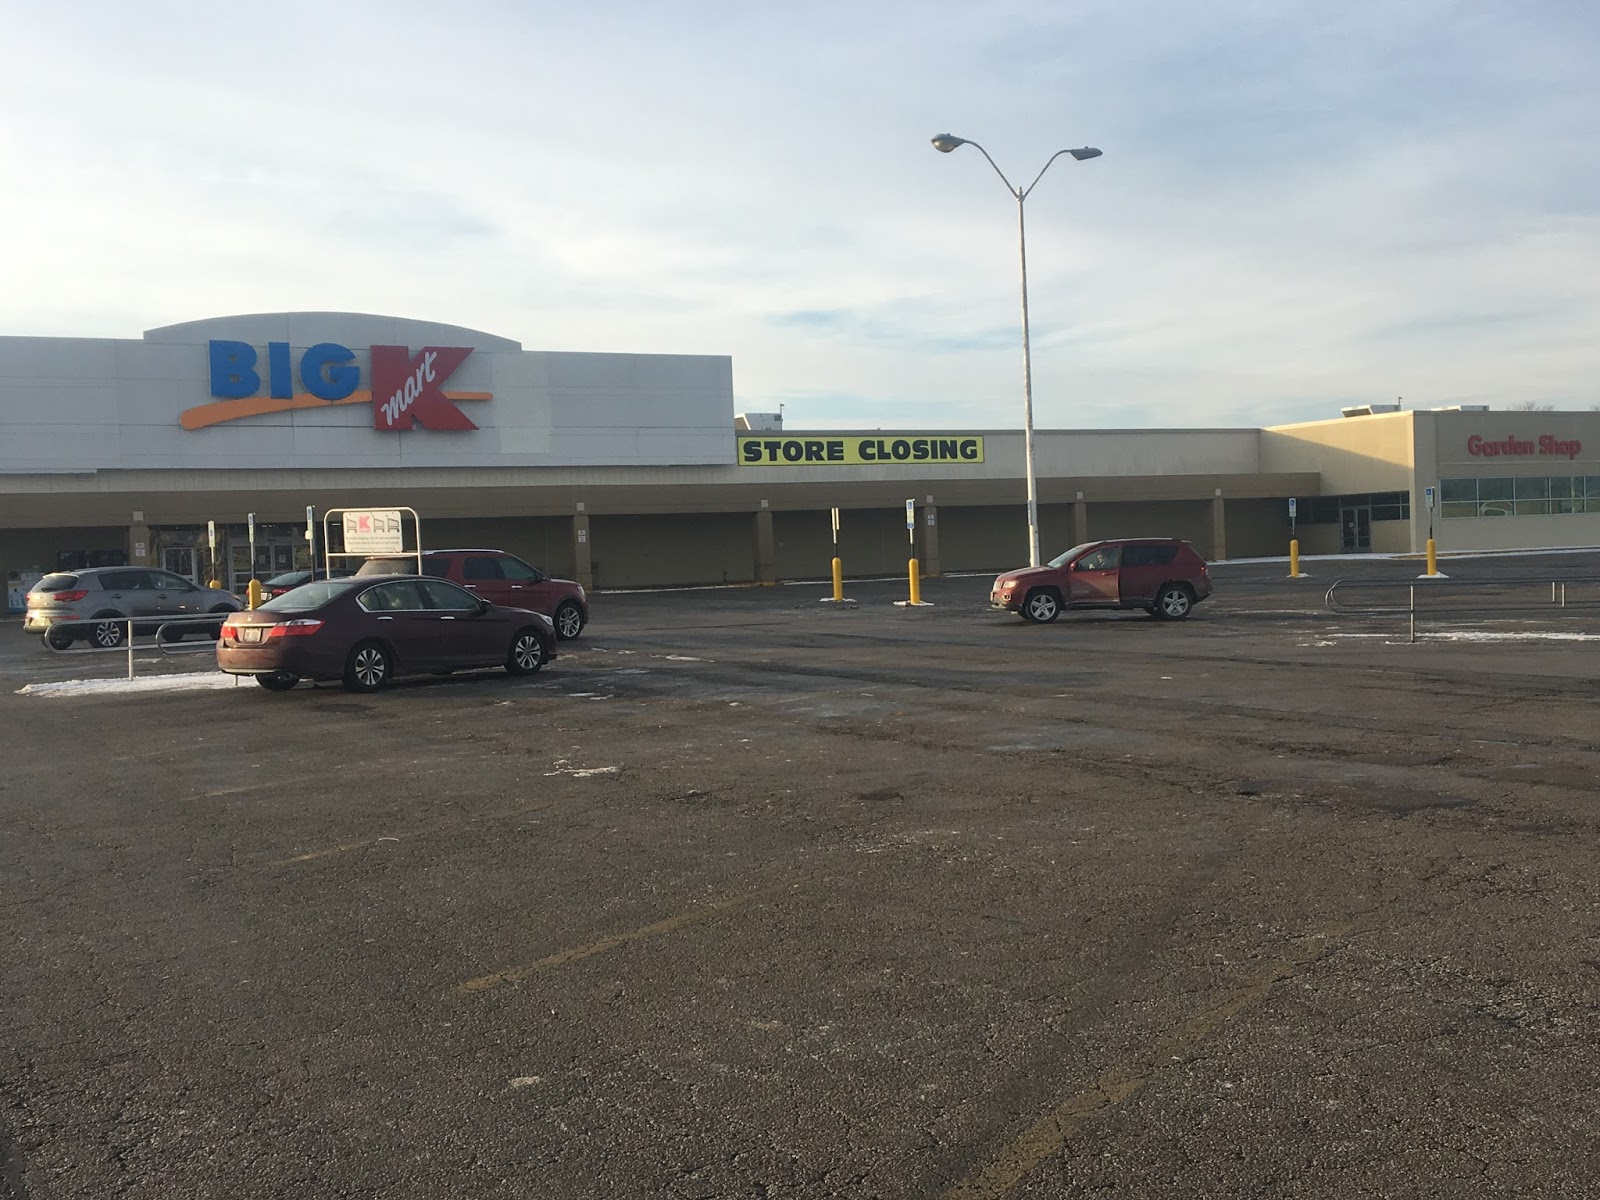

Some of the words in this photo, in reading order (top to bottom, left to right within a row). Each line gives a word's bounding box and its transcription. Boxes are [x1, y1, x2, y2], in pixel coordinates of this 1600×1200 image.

[209, 339, 361, 401] BIG
[369, 344, 480, 431] K
[380, 351, 438, 426] mart
[743, 440, 845, 462] STORE
[858, 439, 978, 460] CLOSING
[1467, 434, 1535, 456] Garden
[1538, 434, 1582, 460] Shop
